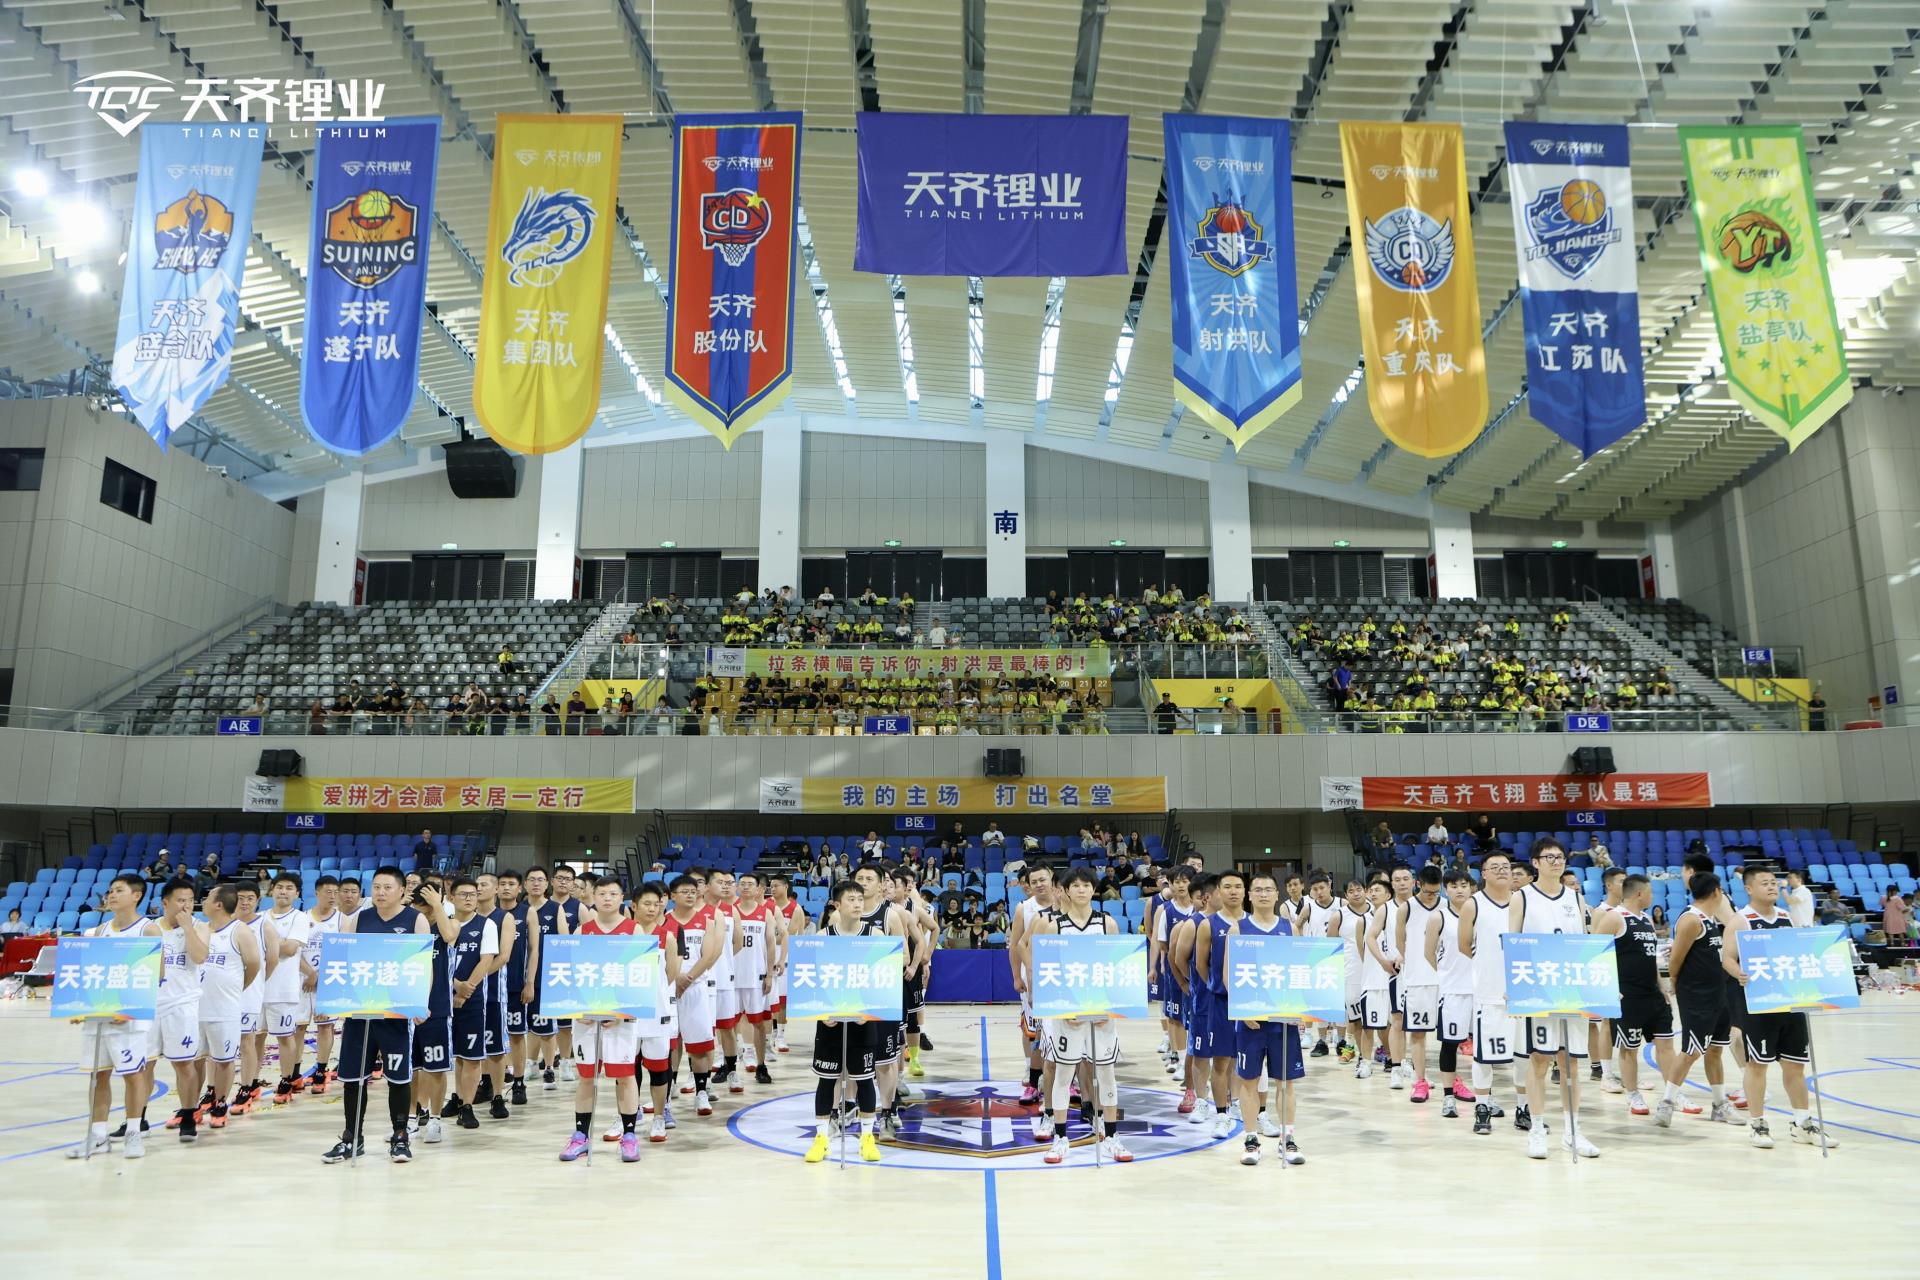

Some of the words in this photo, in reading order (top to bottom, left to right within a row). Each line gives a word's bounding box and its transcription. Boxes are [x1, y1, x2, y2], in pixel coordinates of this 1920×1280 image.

[903, 171, 1083, 208] 天齐锂业
[714, 206, 750, 229] CD
[905, 210, 983, 220] TIANQI
[998, 210, 1084, 220] LITHIUM
[323, 240, 415, 263] SUINING
[1732, 225, 1782, 263] YT
[157, 247, 199, 268] SHENG
[198, 247, 222, 267] HE
[355, 265, 382, 277] ANJU
[708, 294, 756, 318] 天齐
[1210, 293, 1258, 319] 天齐
[1744, 288, 1790, 313] 天齐
[150, 297, 207, 329] 天齐
[339, 299, 390, 327] 天齐
[514, 309, 569, 337] 天齐
[1394, 317, 1444, 343] 天齐
[1551, 312, 1610, 338] 天齐
[1738, 319, 1813, 346] 盐亭队
[135, 329, 215, 362] 盛合队
[324, 335, 400, 363] 遂宁队
[693, 329, 767, 354] 股份队
[1200, 329, 1273, 356] 射洪队
[503, 340, 578, 368] 集团队
[1382, 352, 1463, 376] 重庆队
[1540, 344, 1628, 374] 江苏队
[993, 510, 1018, 534] 南
[1749, 650, 1766, 660] E区
[229, 720, 250, 732] A区
[877, 719, 897, 731] F区
[1577, 716, 1600, 729] D区
[323, 785, 445, 808] 爱拼才会赢
[461, 785, 585, 808] 安居一定行
[842, 784, 960, 808] 我的主场
[995, 784, 1115, 808] 打出名堂
[1403, 783, 1526, 805] 天高齐飞翔
[1538, 781, 1659, 804] 盐亭队最强
[295, 816, 314, 827] A区
[905, 817, 925, 828] B区
[1576, 812, 1596, 824] C区
[1643, 942, 1657, 956] 33
[58, 964, 153, 990] 天齐盛合
[323, 960, 425, 987] 天齐遂宁
[548, 961, 650, 988] 天齐集团
[793, 962, 897, 989] 天齐股份
[1038, 961, 1142, 989] 天齐射洪
[1234, 962, 1339, 990] 天齐重庆
[1511, 960, 1612, 987] 天齐江苏
[1747, 953, 1847, 982] 天齐盐亭
[280, 1015, 292, 1027] 10
[1371, 1011, 1378, 1023] 8
[1413, 1011, 1429, 1025] 24
[1449, 1023, 1457, 1036] 0
[1537, 1026, 1547, 1044] 9
[1628, 1028, 1642, 1041] 33
[181, 1035, 193, 1049] 4
[467, 1034, 477, 1049] 7
[577, 1044, 585, 1061] 4
[1058, 1036, 1068, 1052] 9
[1195, 1036, 1202, 1051] 8
[1488, 1037, 1506, 1054] 15
[1760, 1039, 1767, 1055] 1
[121, 1050, 133, 1064] 3
[387, 1053, 404, 1071] 17
[424, 1045, 444, 1062] 30
